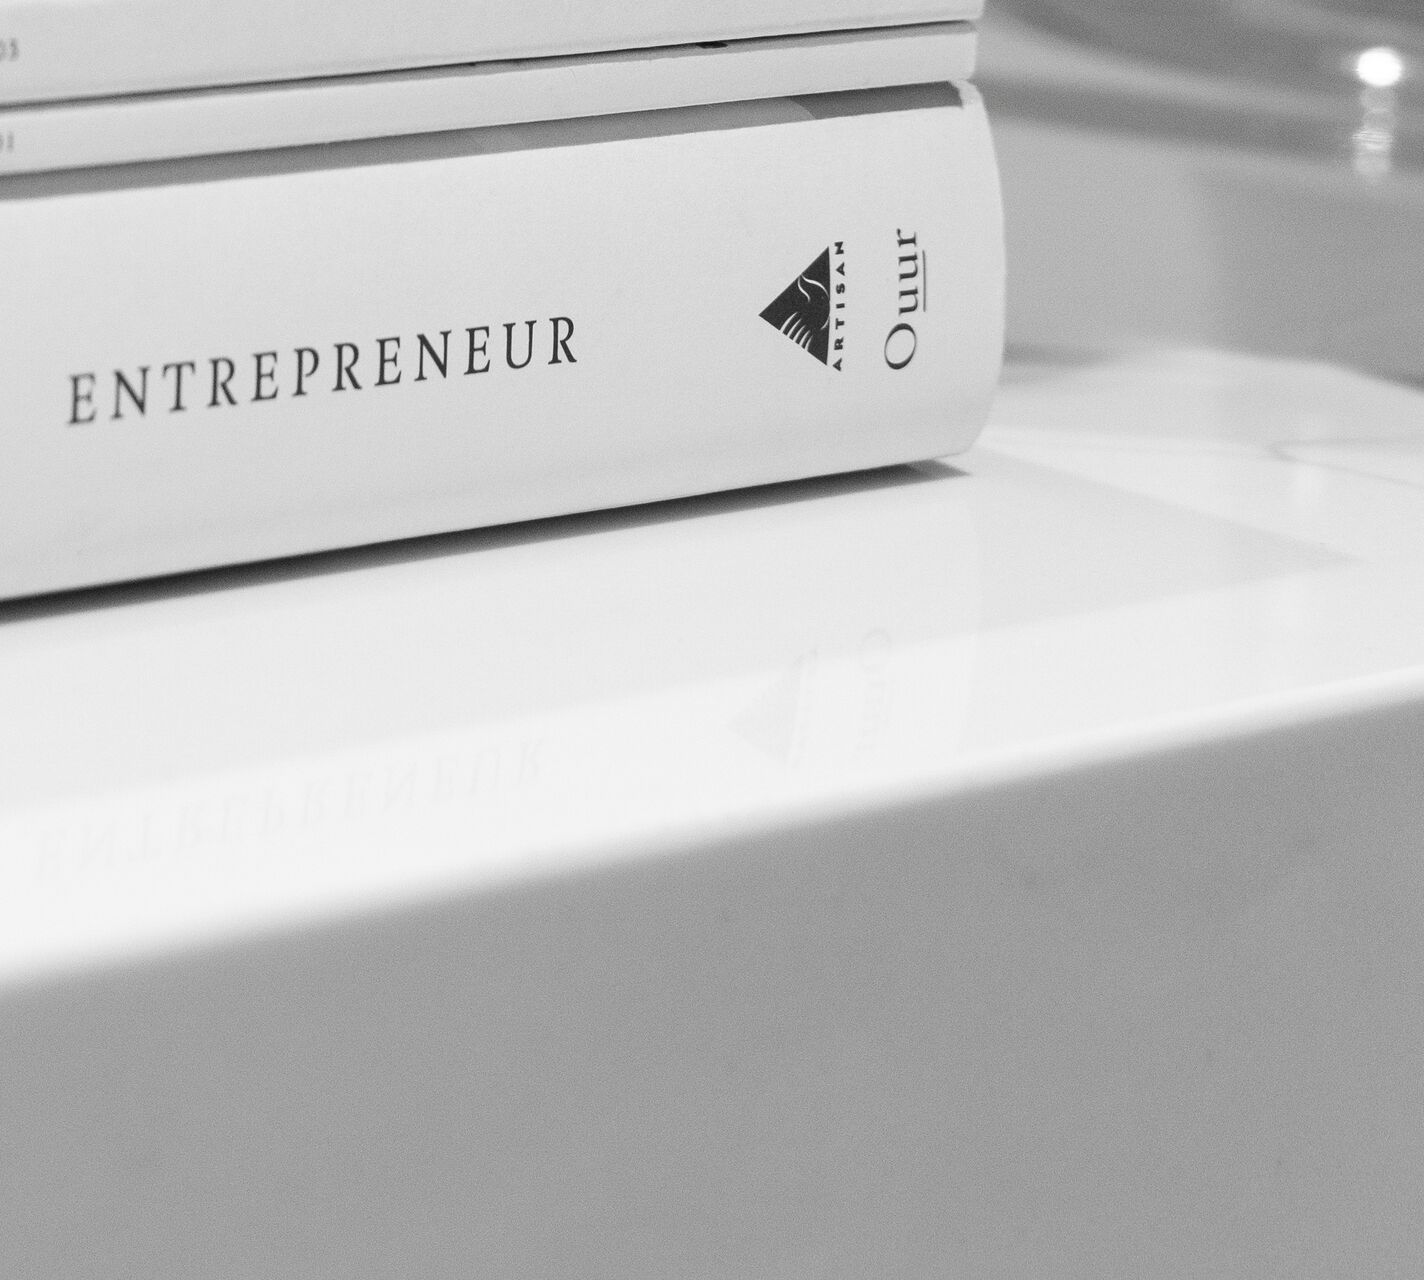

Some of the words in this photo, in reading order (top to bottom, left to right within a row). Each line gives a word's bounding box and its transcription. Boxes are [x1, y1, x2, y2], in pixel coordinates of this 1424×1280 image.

[832, 240, 846, 372] ARTISAN
[884, 228, 922, 372] Ouur
[68, 315, 578, 426] ENTREPRENEUR
